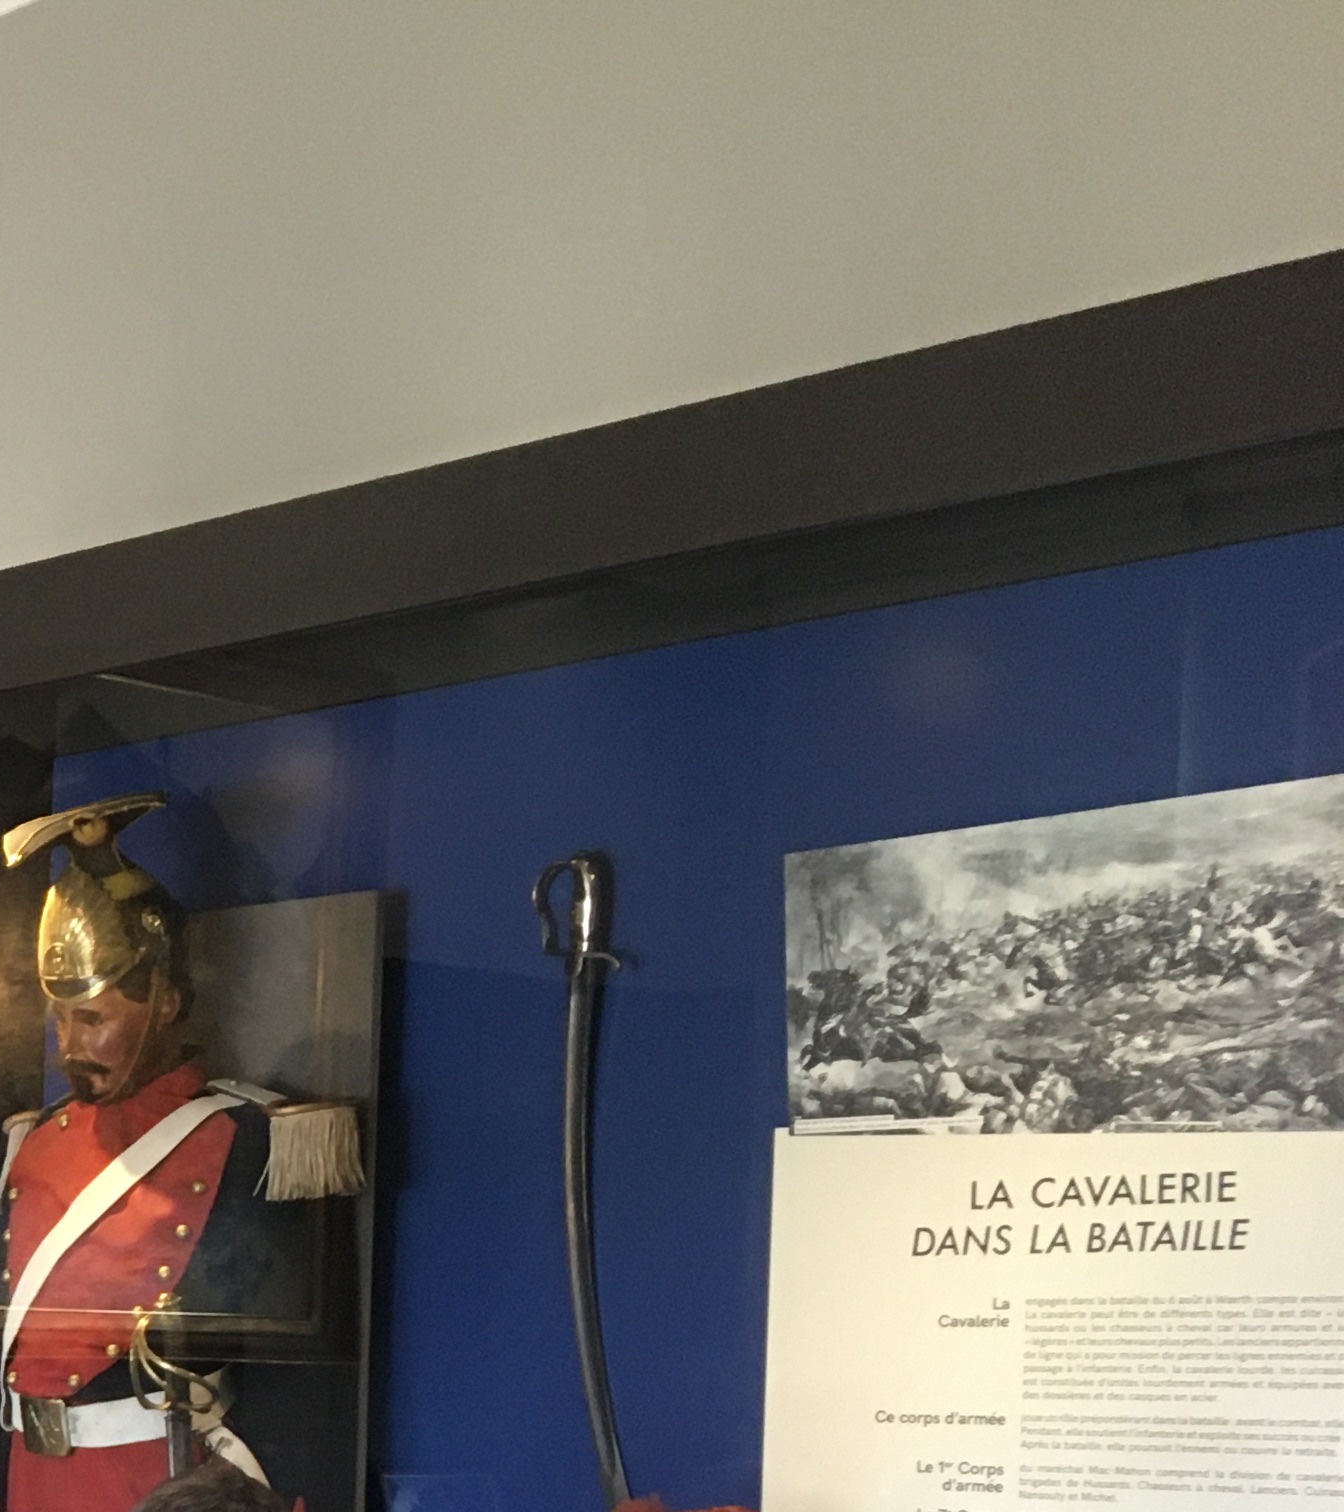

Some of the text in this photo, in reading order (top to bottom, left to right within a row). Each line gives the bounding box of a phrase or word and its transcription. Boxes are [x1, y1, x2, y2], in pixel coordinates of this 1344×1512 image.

[970, 1171, 1237, 1210] LA CAVALERIE
[912, 1218, 1250, 1256] DANS LA BATAILLE
[992, 1298, 1010, 1310] La
[938, 1314, 1010, 1328] Cavalerie
[874, 1410, 894, 1423] Ce
[899, 1414, 940, 1427] corps
[917, 1460, 933, 1473] Le
[958, 1462, 1004, 1478] Corps
